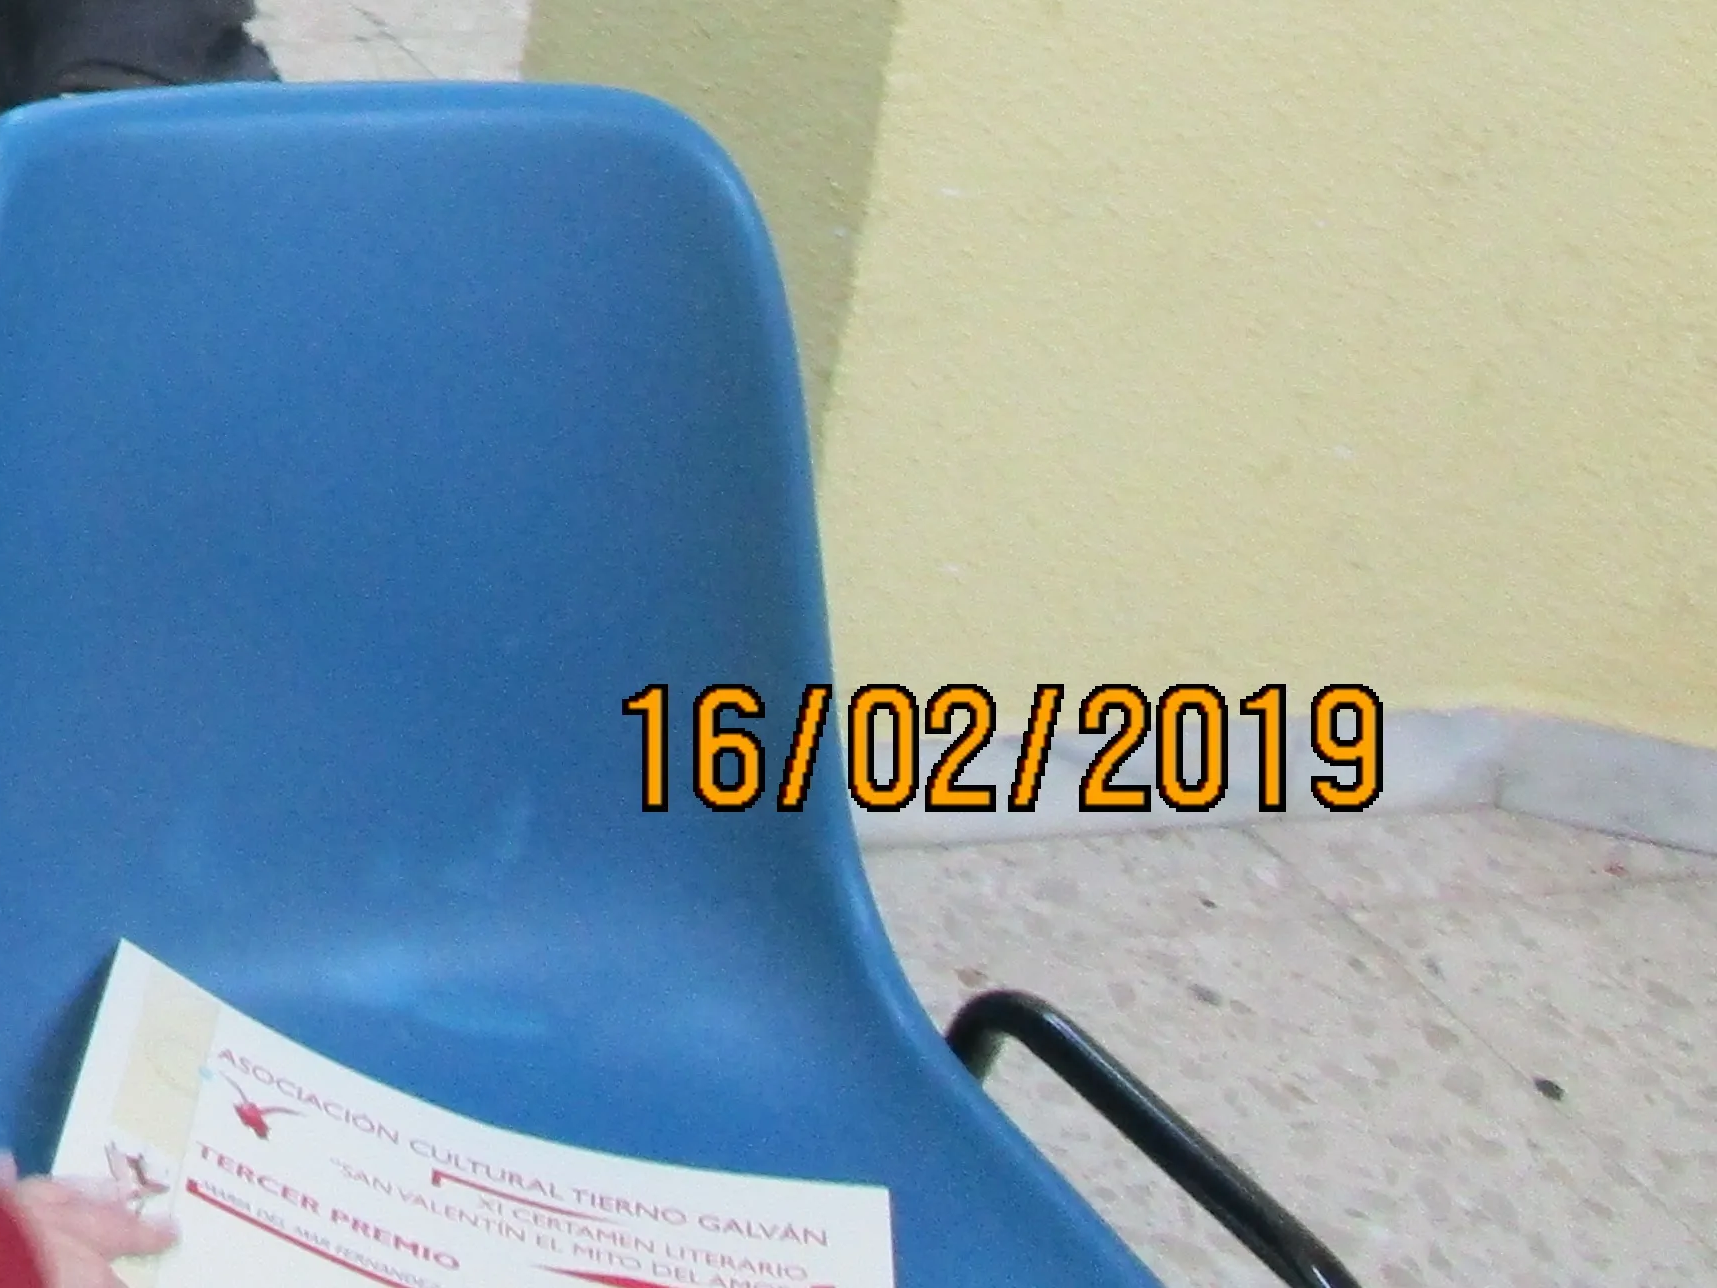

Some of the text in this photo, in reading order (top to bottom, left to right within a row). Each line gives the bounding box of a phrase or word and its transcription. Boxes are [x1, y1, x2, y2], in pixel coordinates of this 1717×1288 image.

[218, 1049, 828, 1247] ASOCIACIÓN CULTURAL TIERNO GALVÁN
[196, 1141, 460, 1271] TERCER PREMIO
[399, 1186, 526, 1242] VALENTÍN
[536, 1234, 563, 1254] EL
[573, 1242, 641, 1270] MITO
[652, 1261, 699, 1284] DEL
[479, 1195, 808, 1281] XI CERTAMEN LITERARIO
